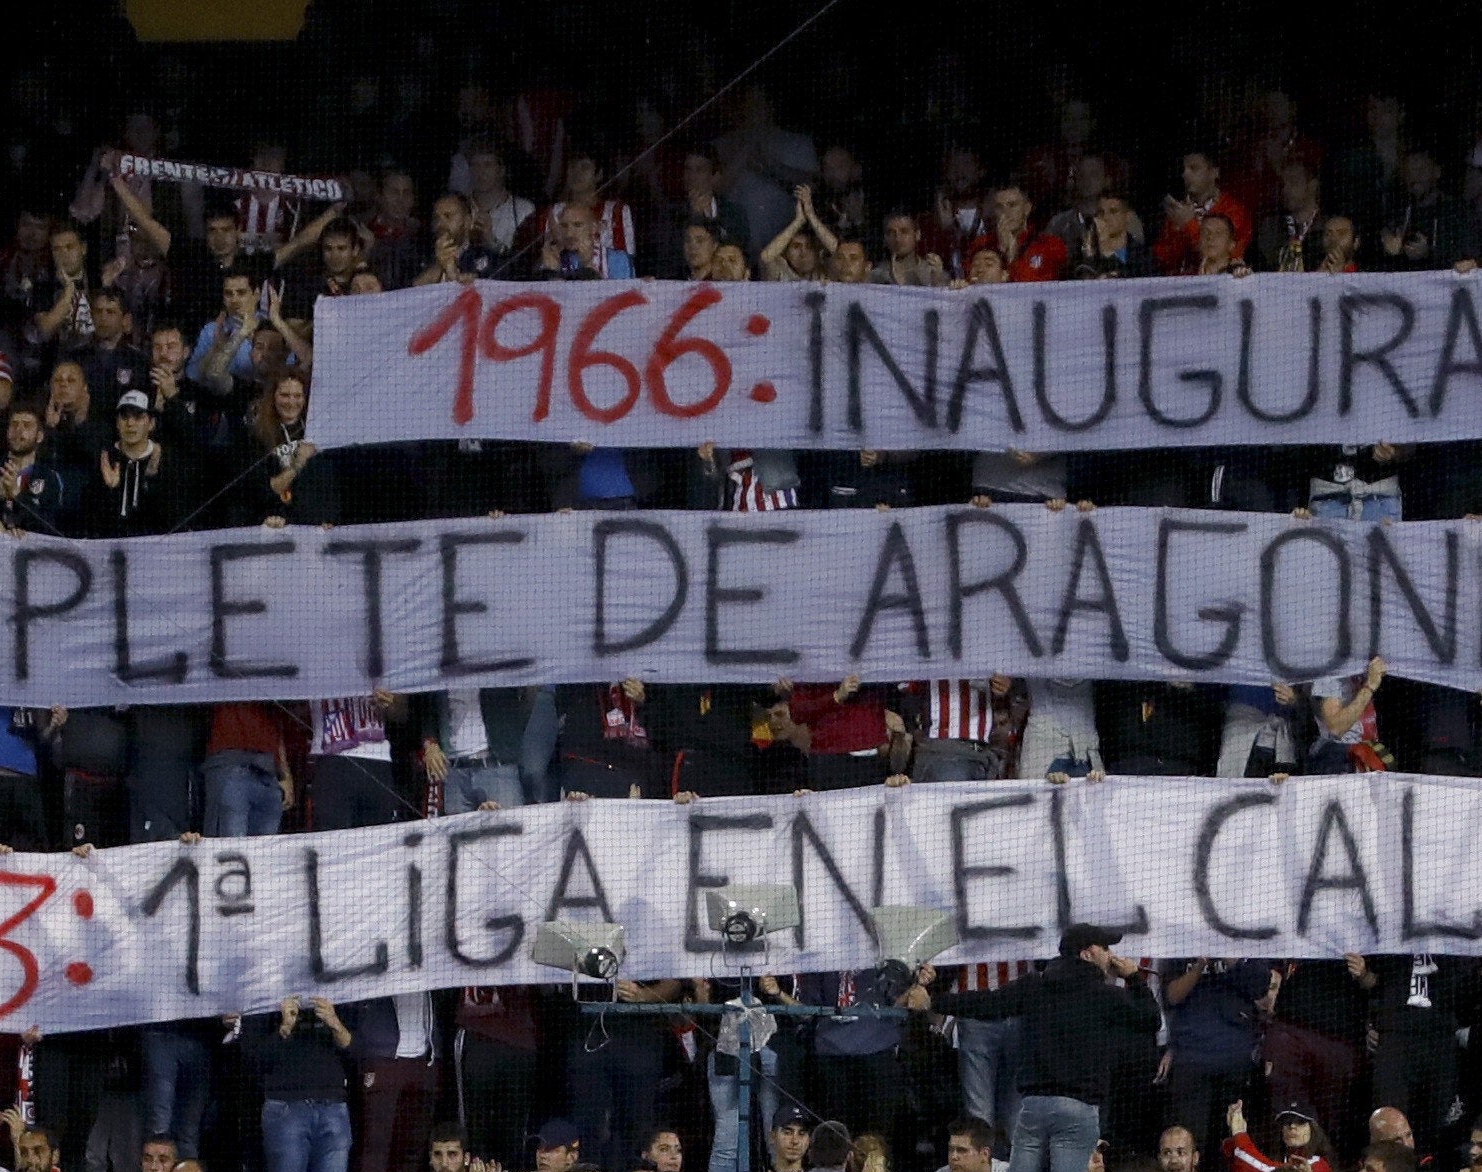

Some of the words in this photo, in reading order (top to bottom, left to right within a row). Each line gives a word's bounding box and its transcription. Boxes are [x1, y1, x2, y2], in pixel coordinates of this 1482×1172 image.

[119, 153, 208, 184] FRENTE
[407, 284, 779, 428] 1966:
[591, 518, 803, 664] DE
[684, 804, 887, 955] EN
[951, 790, 1149, 940] EL
